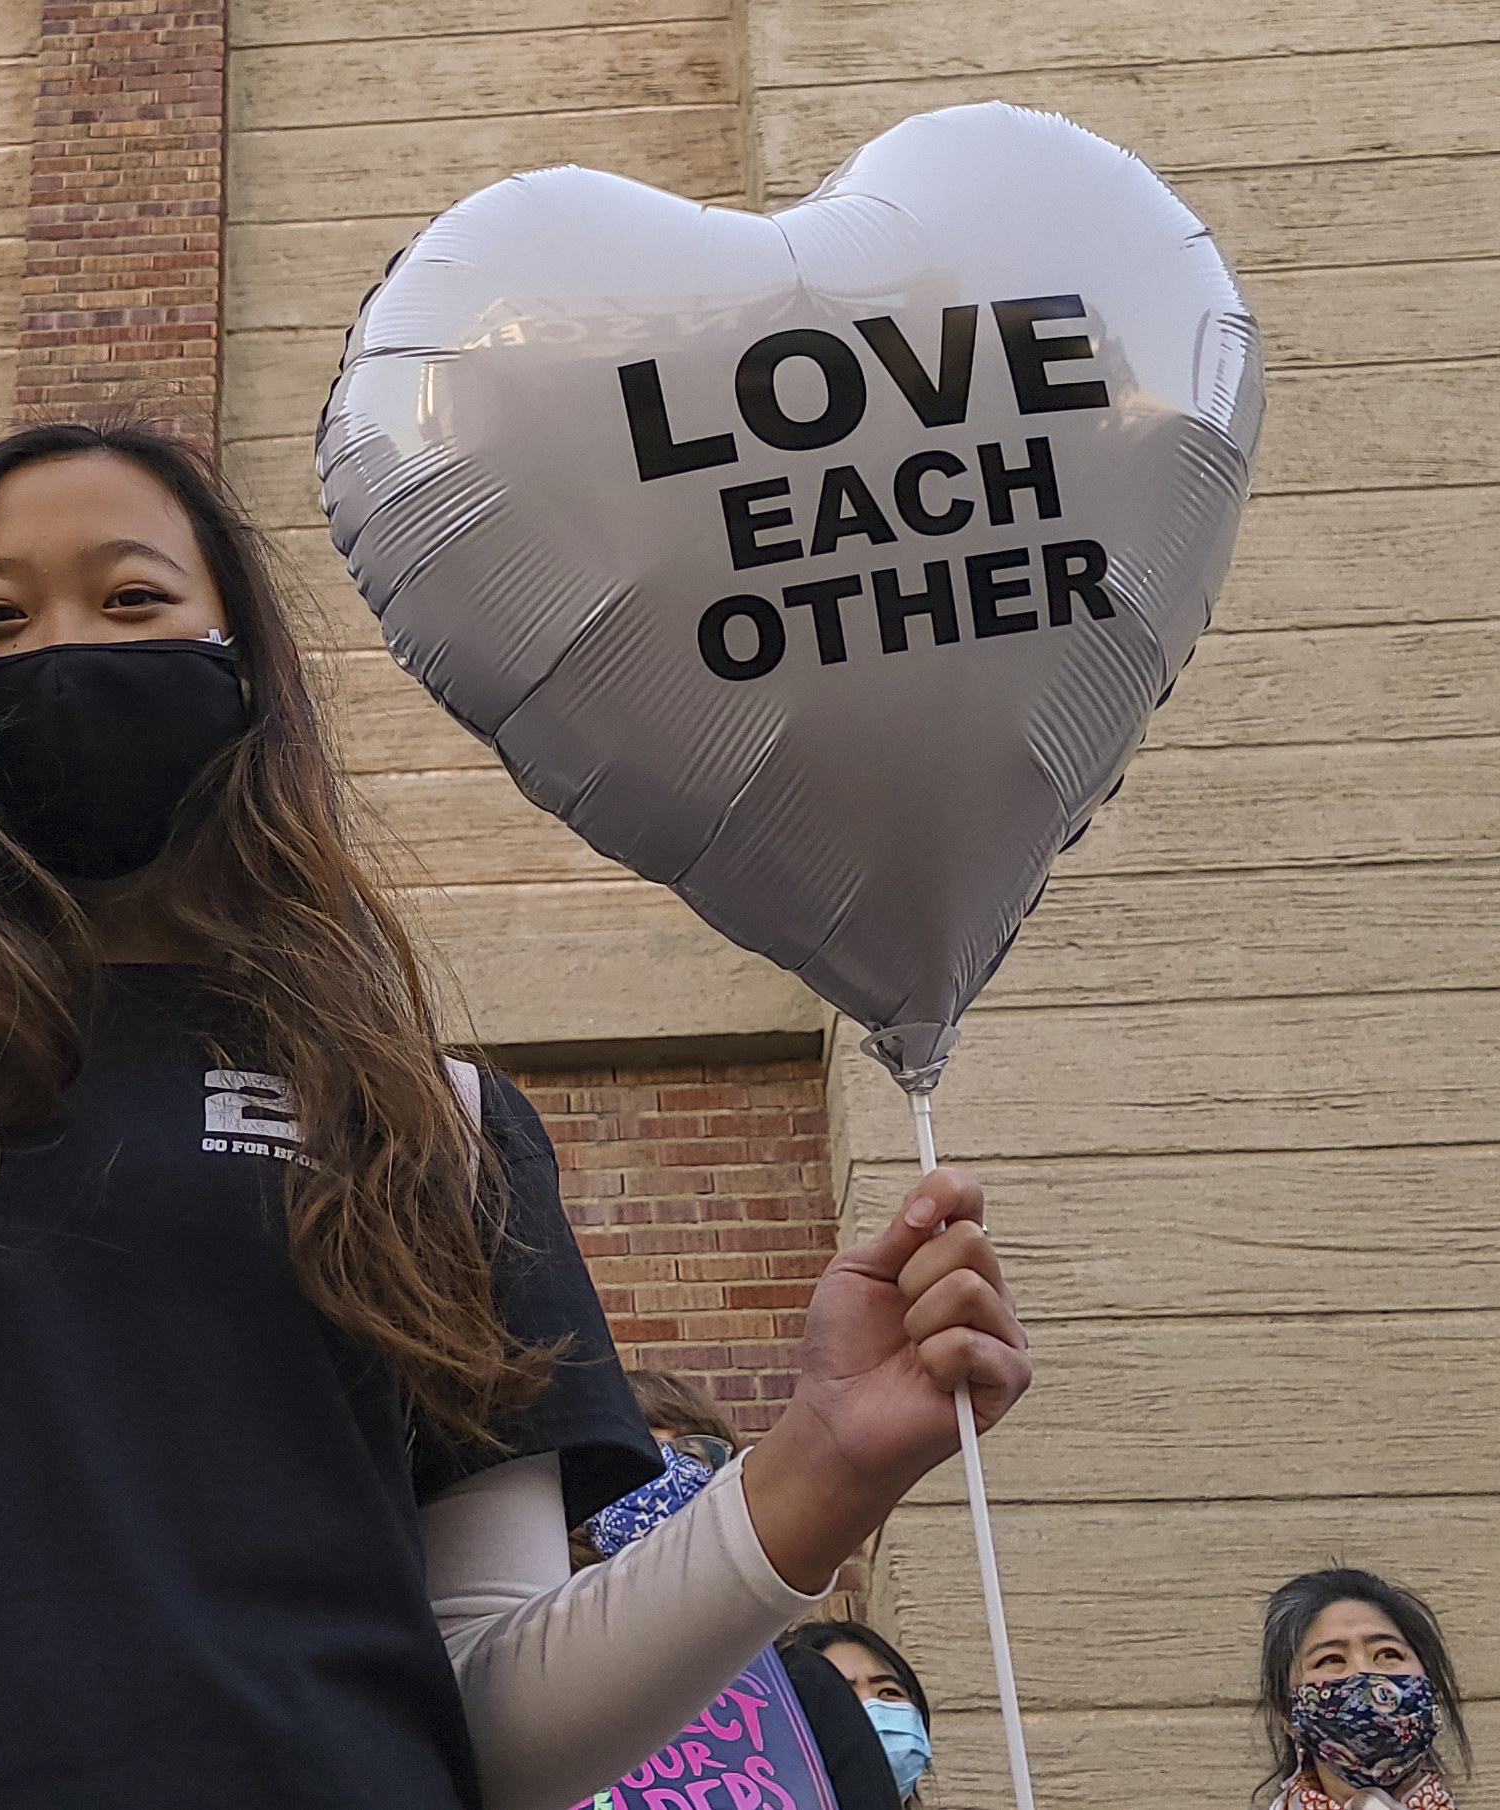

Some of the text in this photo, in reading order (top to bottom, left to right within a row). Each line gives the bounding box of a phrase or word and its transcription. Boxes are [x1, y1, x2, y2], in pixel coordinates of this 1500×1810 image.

[617, 294, 1111, 482] LOVE
[719, 436, 1062, 571] EACH
[697, 539, 1116, 682] OTHER
[202, 1138, 228, 1152] GO
[232, 1141, 270, 1156] FOR
